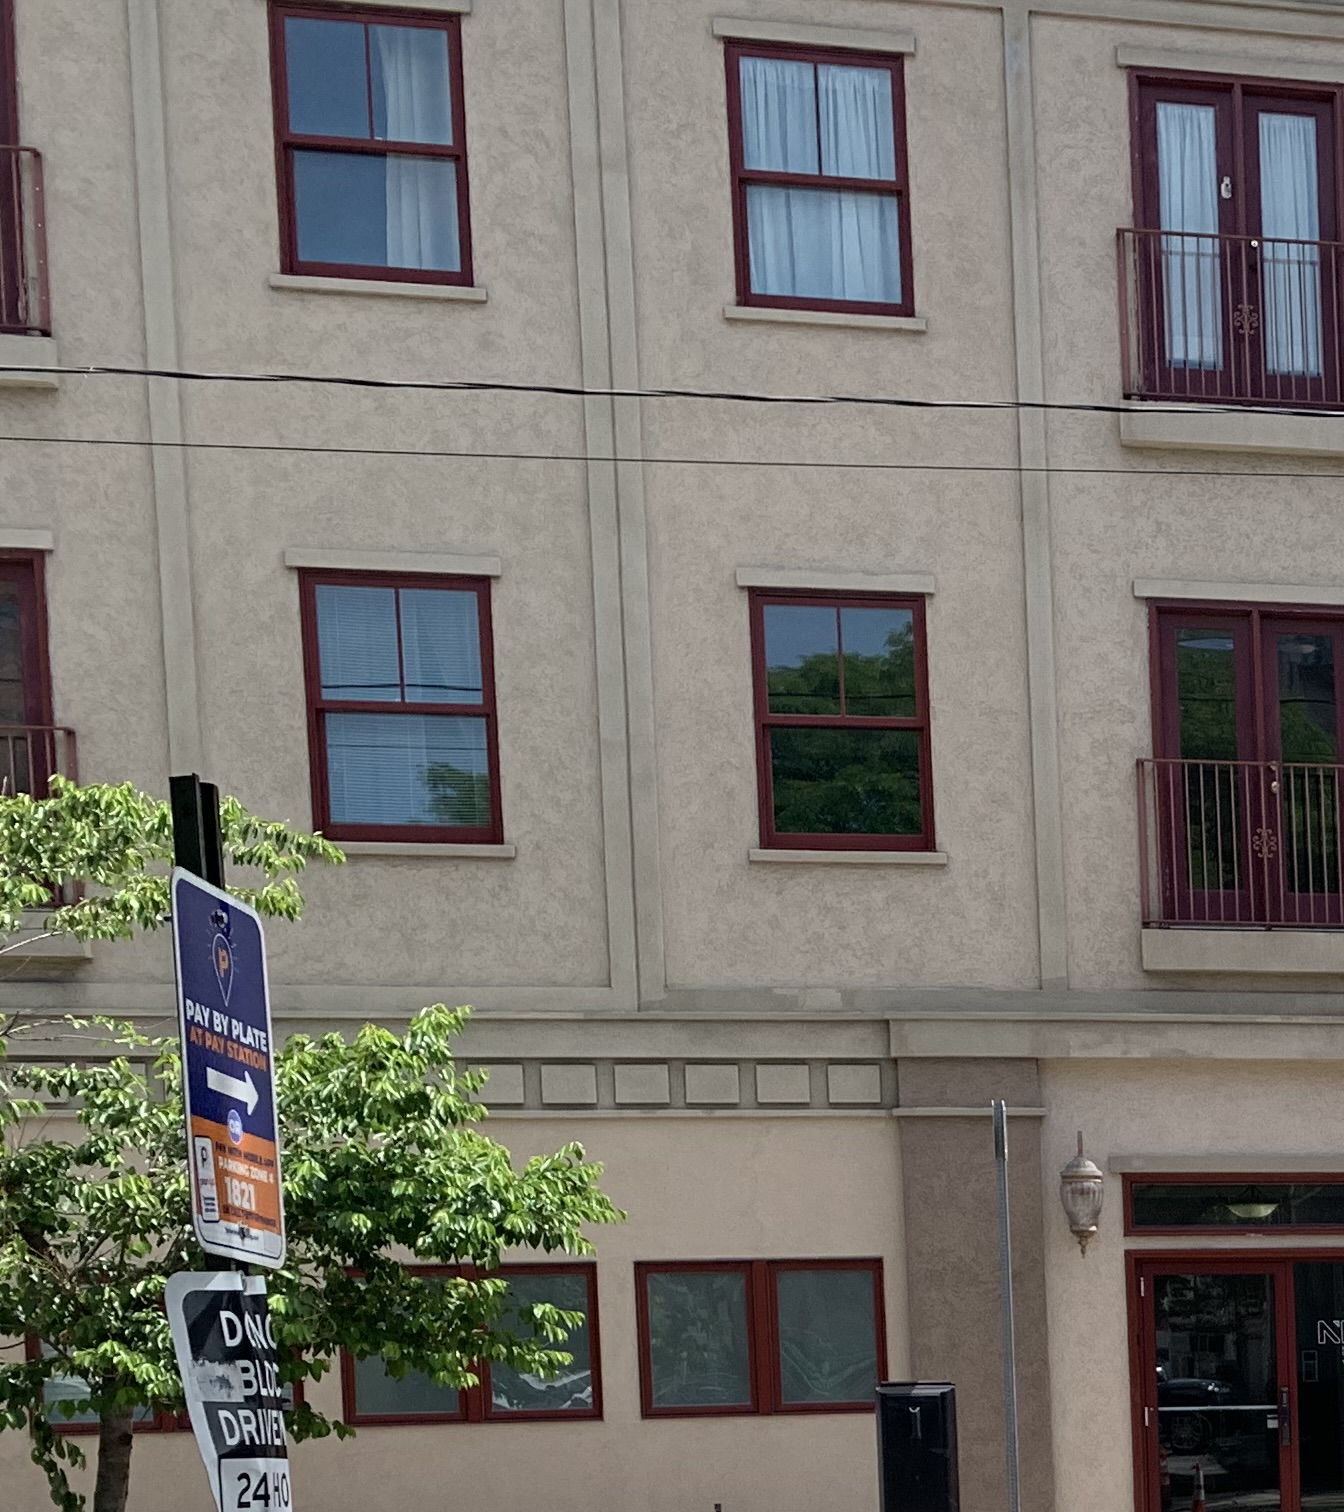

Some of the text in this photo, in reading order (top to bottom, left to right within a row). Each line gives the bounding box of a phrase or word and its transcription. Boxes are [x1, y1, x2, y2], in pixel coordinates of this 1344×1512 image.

[185, 998, 268, 1053] PAY BY PLATE
[190, 1025, 267, 1072] AT PAY STATION
[228, 1118, 241, 1134] OR
[218, 1155, 249, 1179] PARKING
[224, 1176, 256, 1211] 1821
[236, 1471, 270, 1509] 24
